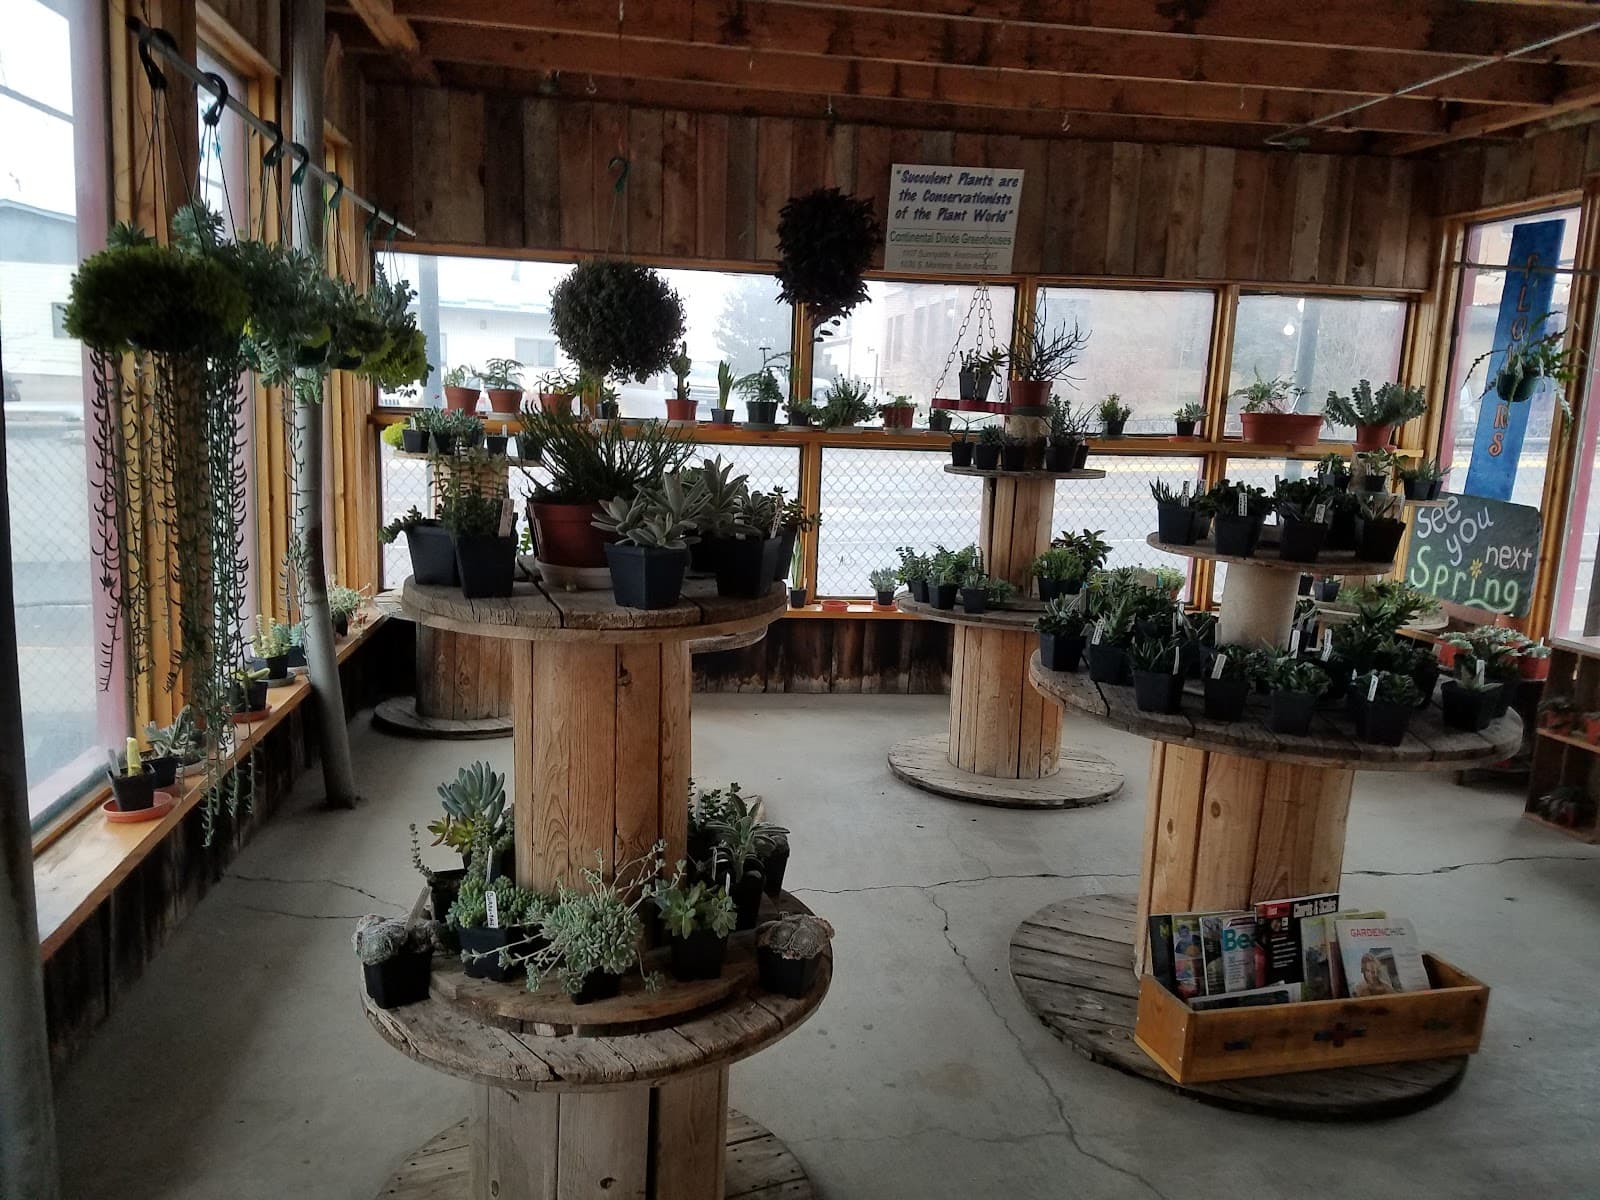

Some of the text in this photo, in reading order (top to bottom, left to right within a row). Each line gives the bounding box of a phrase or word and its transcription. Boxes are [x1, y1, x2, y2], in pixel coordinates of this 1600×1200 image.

[957, 172, 994, 187] Plants
[998, 176, 1019, 188] are
[899, 187, 1012, 205] the Conservationists
[895, 206, 909, 219] of
[913, 206, 931, 220] the
[936, 208, 967, 221] Plant
[890, 230, 1012, 245] Continental Divide Greenhouses
[1417, 496, 1461, 538] see
[1446, 506, 1494, 567] you
[1485, 545, 1532, 571] next
[1410, 545, 1519, 613] Spring
